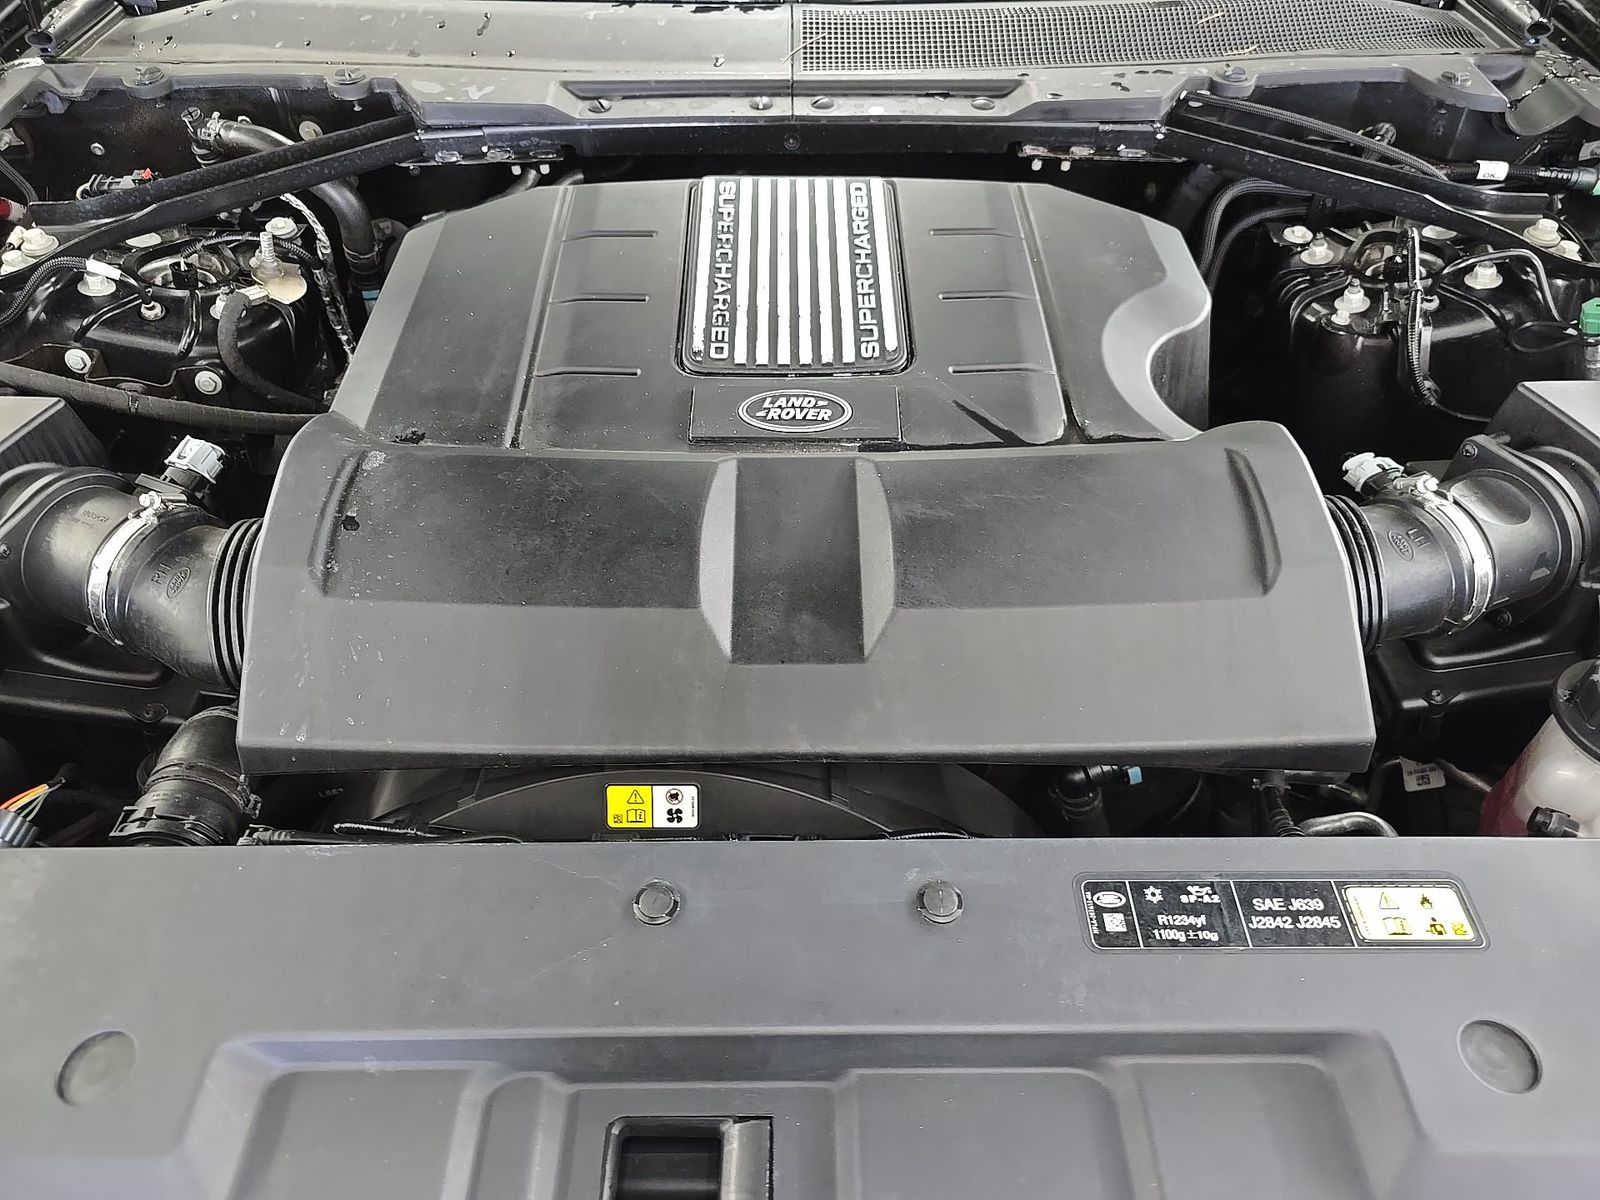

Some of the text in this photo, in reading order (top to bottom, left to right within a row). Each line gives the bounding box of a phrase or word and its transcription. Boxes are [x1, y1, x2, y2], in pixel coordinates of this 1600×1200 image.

[709, 180, 737, 360] SUPERCHARGED
[850, 181, 880, 359] SUPERCHARGED
[763, 396, 817, 408] LAND
[766, 408, 832, 421] ROVER
[1252, 898, 1325, 911] SAE J639
[1157, 914, 1207, 928] R1234yf
[1248, 916, 1341, 929] J2842 J2845
[1152, 929, 1187, 943] 1100g
